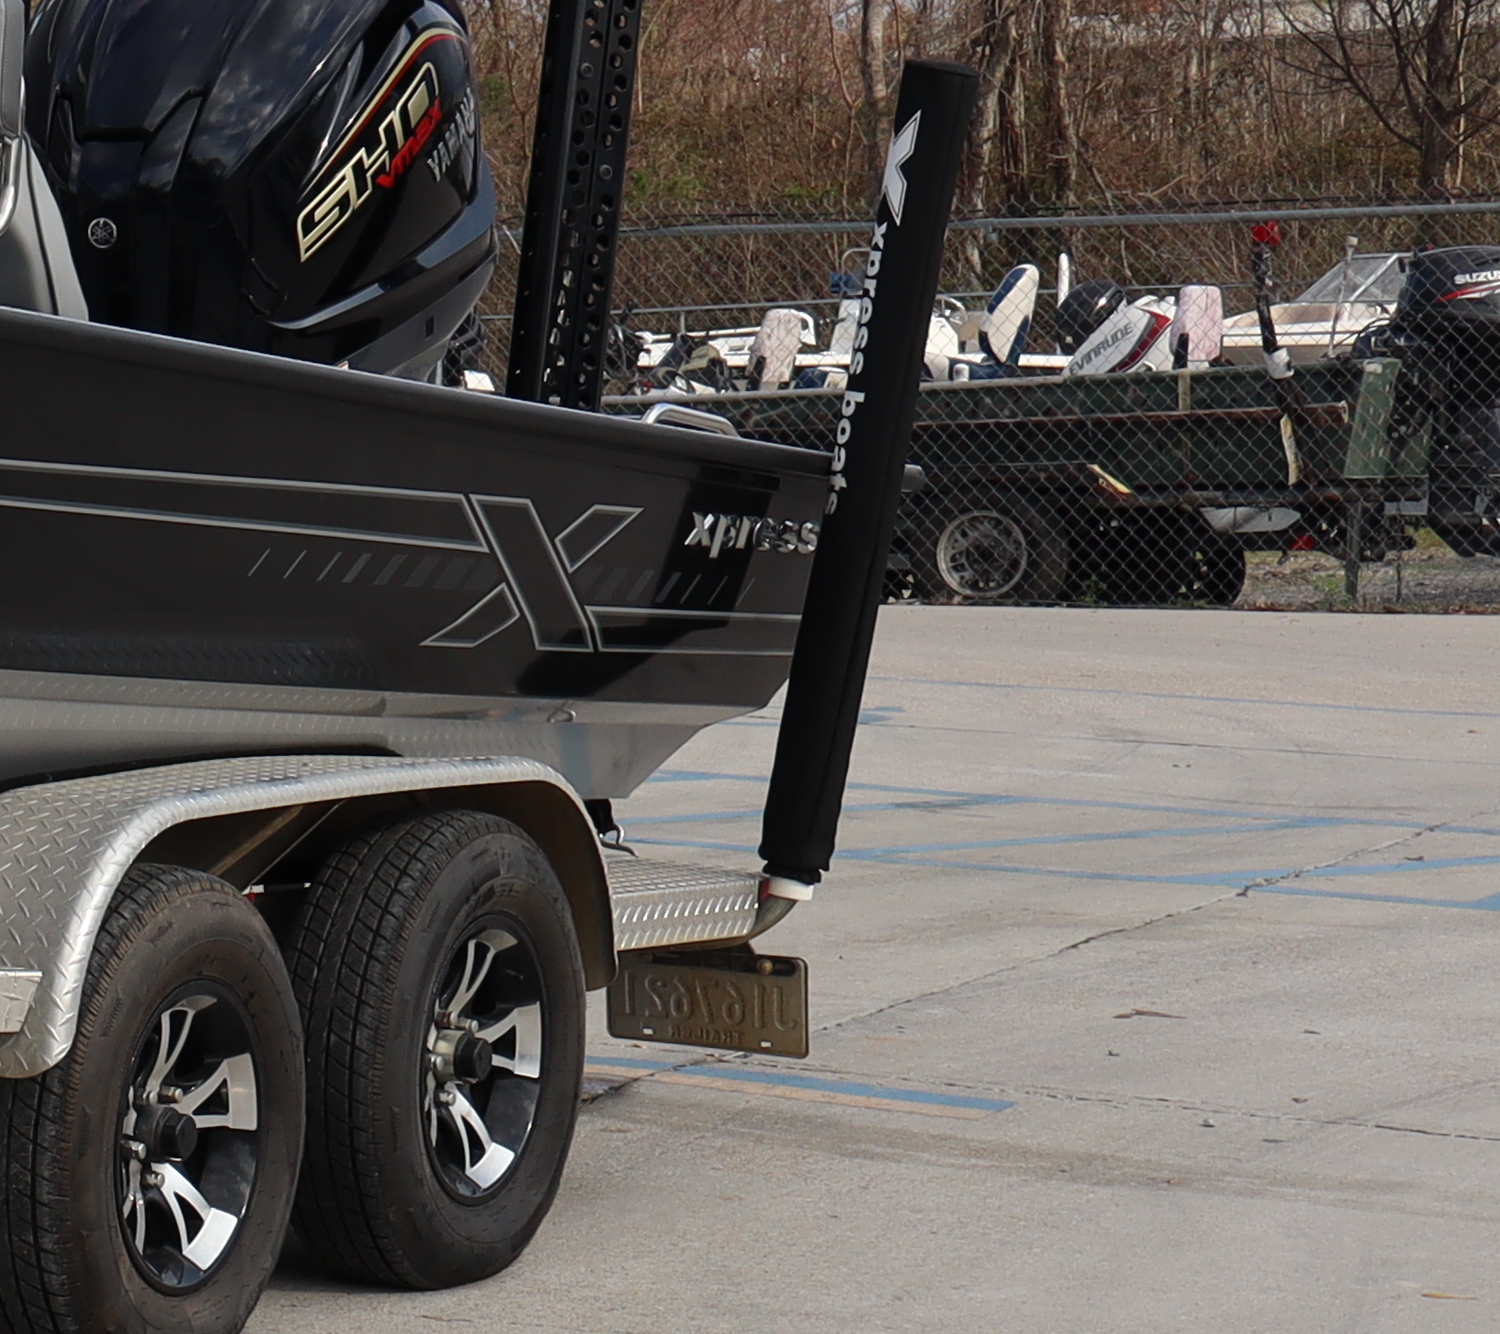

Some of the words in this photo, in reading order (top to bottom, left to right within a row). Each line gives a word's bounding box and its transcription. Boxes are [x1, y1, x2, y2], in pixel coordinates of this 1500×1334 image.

[297, 61, 440, 263] SHO
[1453, 270, 1500, 285] SUZU
[1069, 322, 1134, 375] EVINRUDE
[684, 511, 821, 559] xpress
